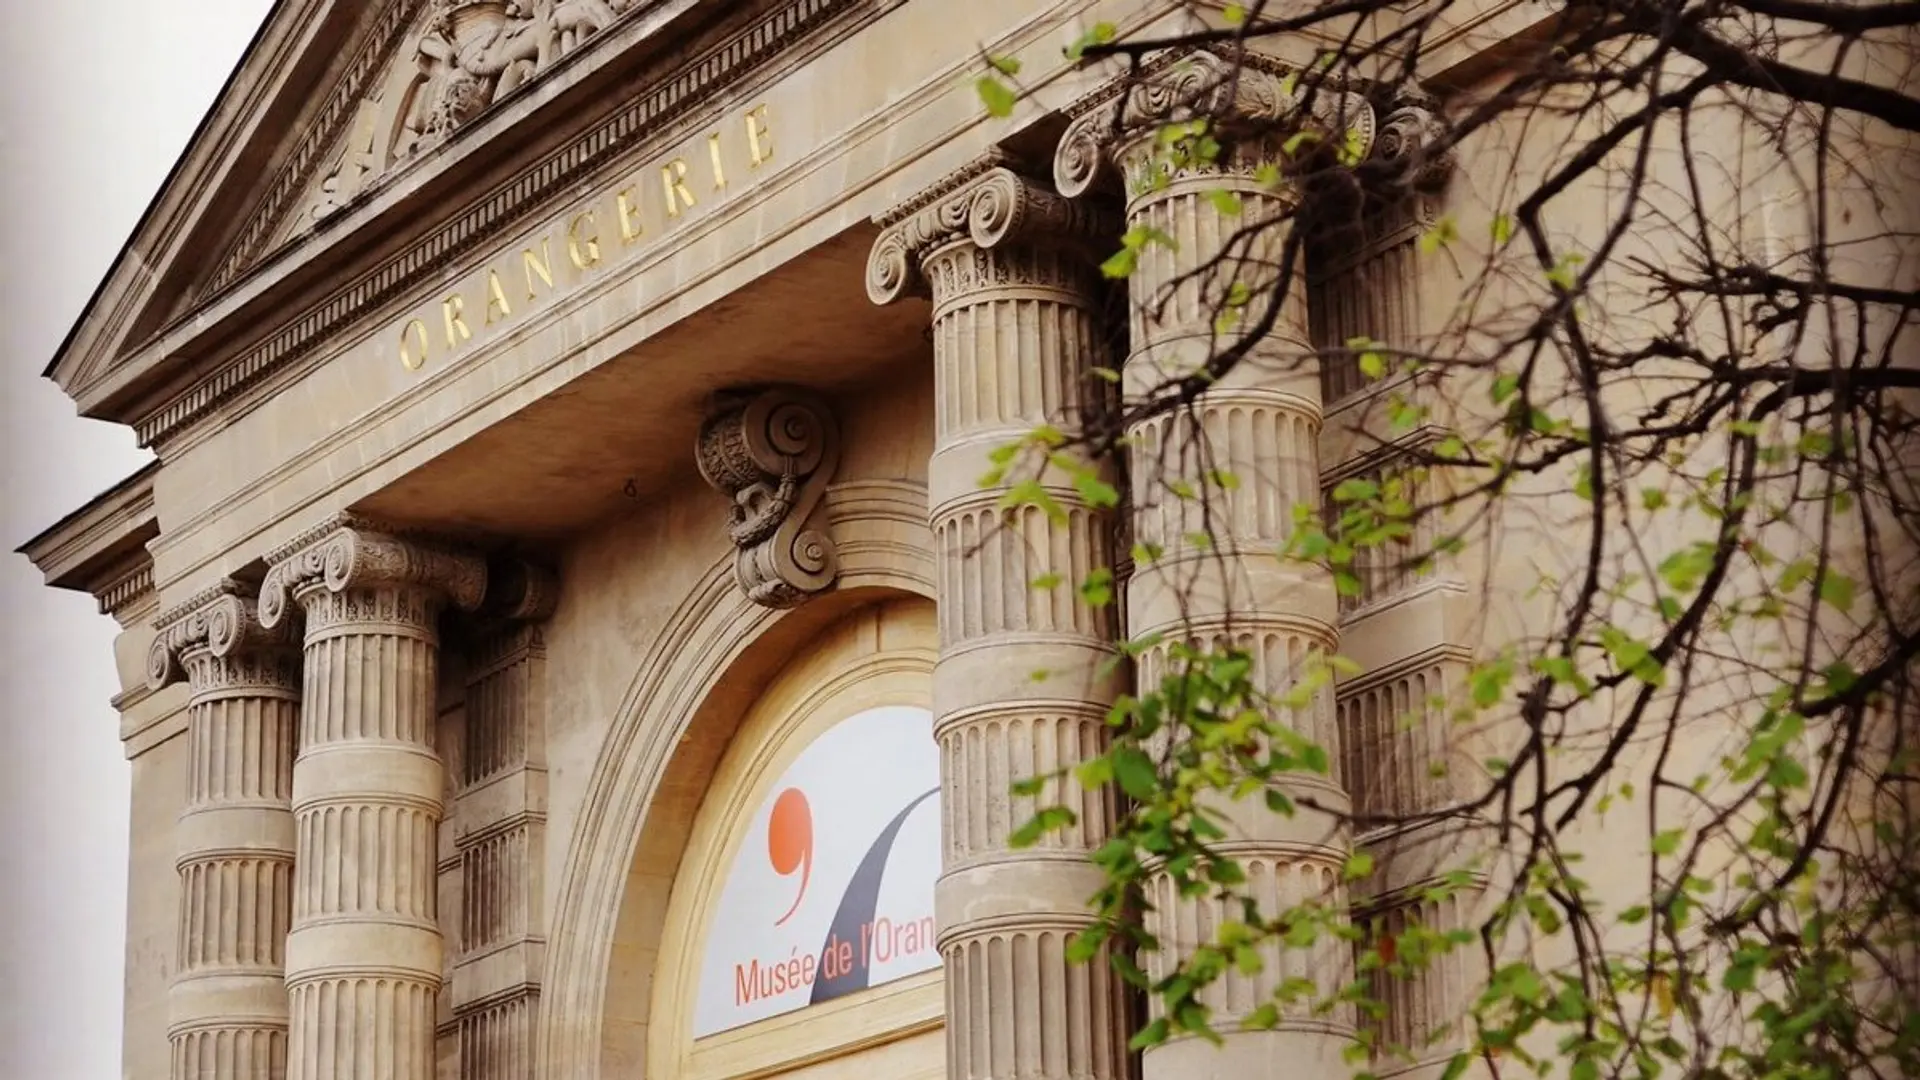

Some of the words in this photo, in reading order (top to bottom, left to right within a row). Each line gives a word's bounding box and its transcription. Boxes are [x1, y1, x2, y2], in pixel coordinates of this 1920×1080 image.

[400, 103, 773, 371] ORANGERIE
[735, 945, 815, 1006] Musée
[823, 934, 852, 979] de
